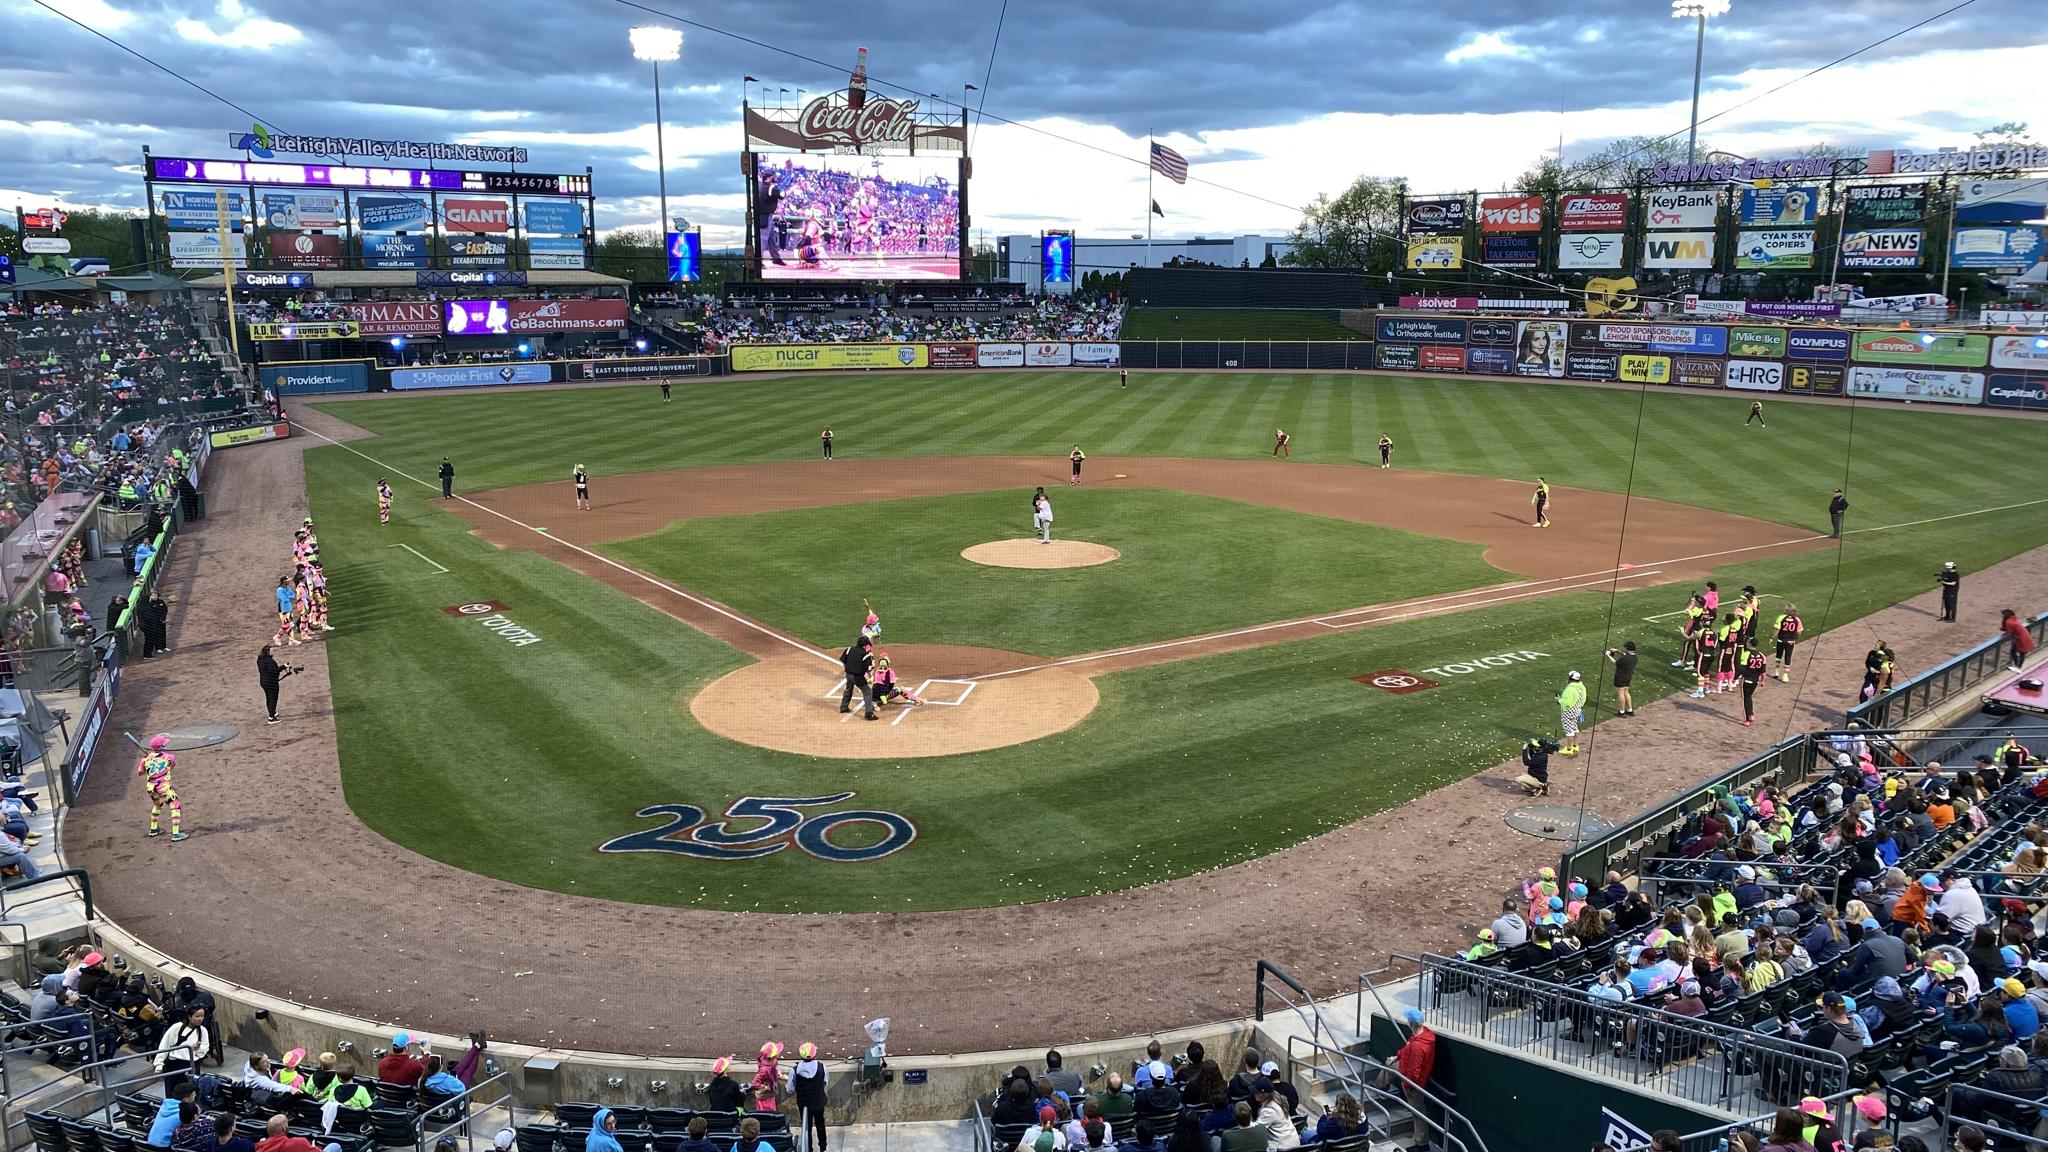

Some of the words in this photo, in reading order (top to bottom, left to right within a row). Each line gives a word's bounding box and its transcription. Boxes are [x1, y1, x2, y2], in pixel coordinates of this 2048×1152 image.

[799, 97, 920, 142] Coca-Cola
[274, 135, 338, 156] Lehigh
[338, 138, 394, 160] Valley
[396, 141, 450, 159] Health
[454, 144, 526, 162] Network
[834, 144, 883, 156] PARK
[1894, 144, 2048, 173] PenTeleData
[1653, 163, 1734, 183] SERVICE
[1740, 158, 1836, 179] ELECTRIC
[1851, 188, 1880, 199] IBEW
[1881, 187, 1901, 198] 375
[1652, 194, 1713, 209] KeyBank
[1864, 200, 1916, 209] POWERING
[531, 206, 555, 214] Working
[1450, 204, 1460, 212] 50
[1484, 203, 1540, 224] weis
[364, 215, 388, 223] FOR
[390, 212, 422, 220] NEWS
[447, 209, 505, 223] GIANT
[532, 223, 551, 231] Giving
[1868, 234, 1918, 249] NEWS
[1505, 251, 1536, 259] SERVICE
[1649, 240, 1706, 259] WM
[1844, 257, 1916, 266] WFMZ.COM
[247, 274, 287, 286] Capital
[451, 273, 483, 283] Capital
[510, 318, 624, 329] GoBachmans.com
[1397, 322, 1419, 330] Lehigh
[1419, 323, 1438, 331] Valley
[1396, 330, 1433, 338] Orthopedic
[1434, 331, 1460, 339] Institute
[1603, 333, 1630, 341] LEHIGH
[1631, 334, 1657, 342] VALLEY
[1736, 333, 1761, 342] Mike
[1764, 333, 1780, 344] Ike
[1791, 338, 1847, 347] OLYMPUS
[1872, 343, 1914, 351] SERVPRO
[777, 348, 820, 361] nucar
[1088, 346, 1113, 354] Family
[613, 365, 658, 373] STROUDSBURG
[1628, 360, 1646, 368] PLAY
[1676, 361, 1721, 372] KUTZTOWN
[288, 376, 332, 386] Provident
[428, 372, 466, 383] People
[469, 370, 494, 381] First
[1741, 367, 1779, 384] HRG
[1793, 368, 1809, 387] B
[1885, 371, 1914, 380] SERVICE
[1915, 372, 1946, 381] ELECTRIC
[476, 614, 541, 646] TOYOTA
[1783, 622, 1796, 632] 20
[1422, 650, 1550, 677] TOYOTA
[1750, 658, 1762, 669] 23
[597, 792, 918, 862] 250
